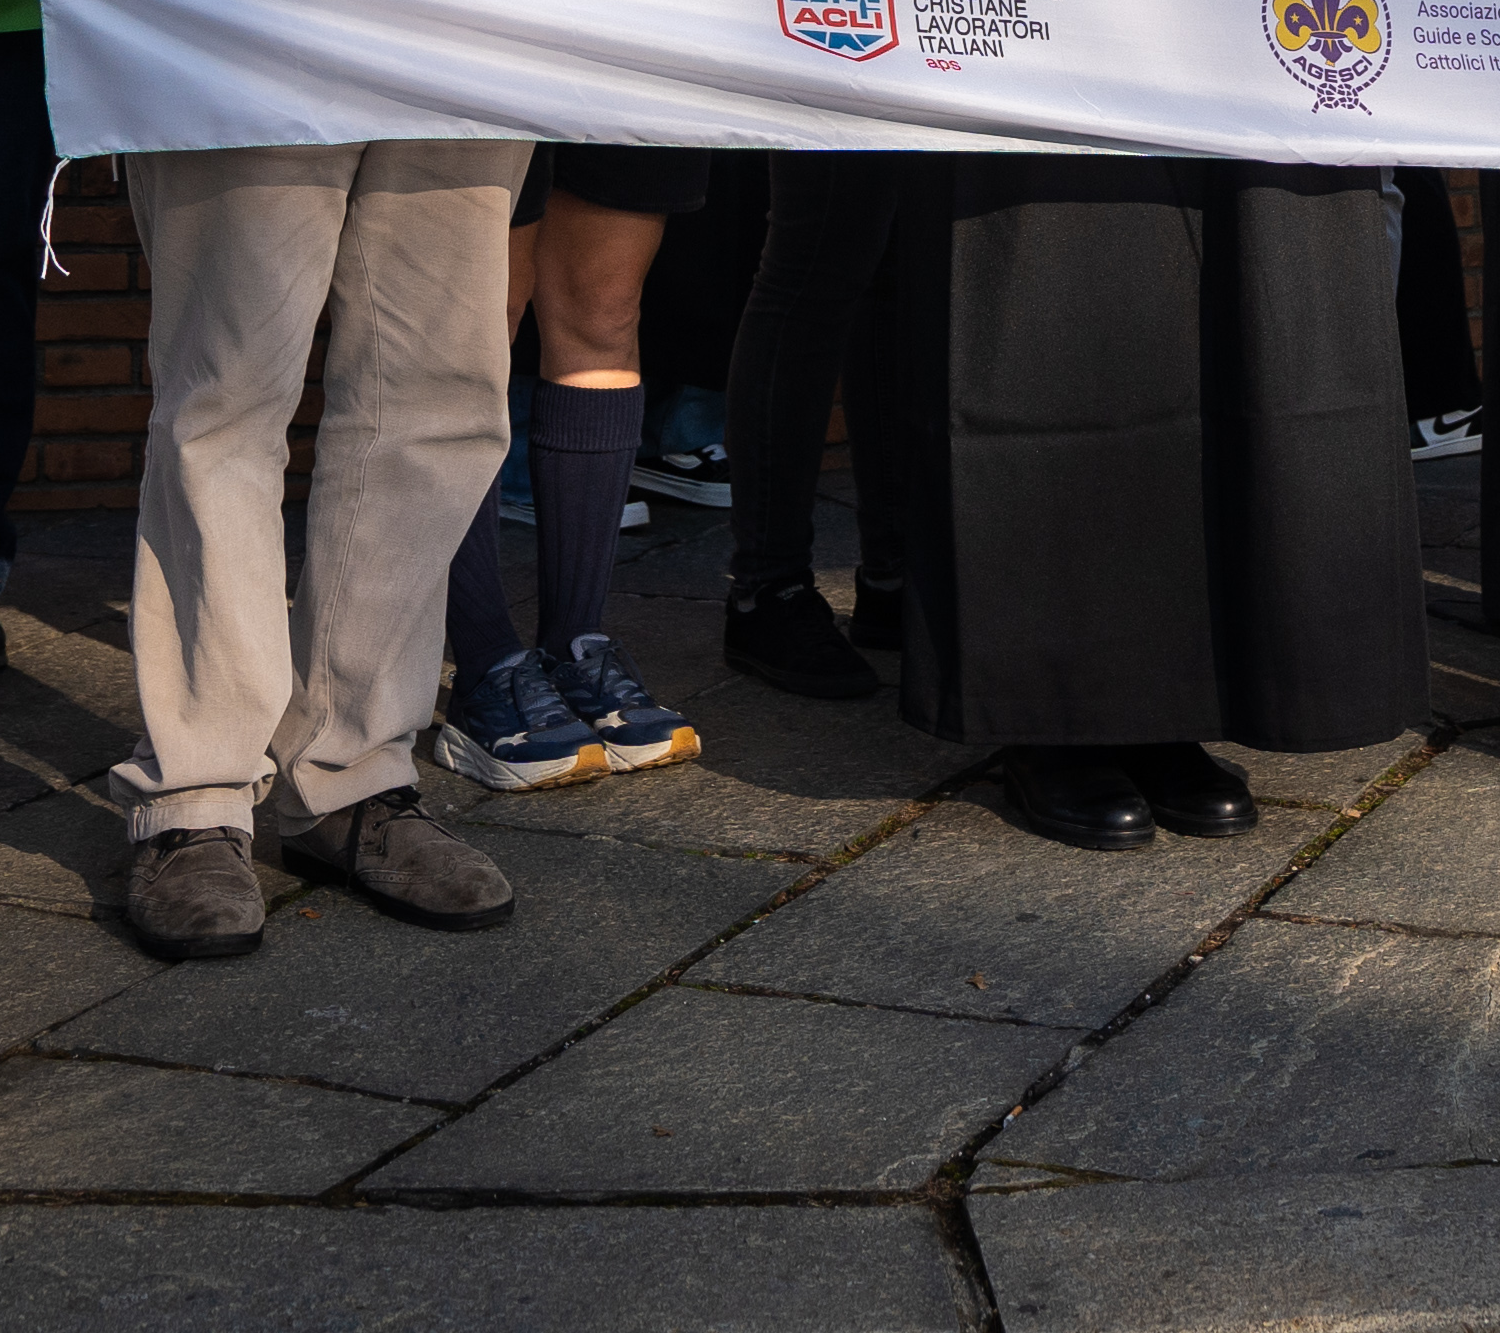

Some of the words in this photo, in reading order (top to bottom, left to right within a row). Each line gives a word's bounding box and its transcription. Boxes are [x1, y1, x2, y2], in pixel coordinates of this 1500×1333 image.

[915, 14, 1050, 40] LAVORATORI
[1413, 26, 1462, 45] Guide
[1466, 33, 1476, 45] e
[918, 35, 1004, 58] ITALIANI
[926, 58, 962, 72] aps
[1292, 55, 1373, 83] AGESCI
[1415, 53, 1485, 72] Cattolici
